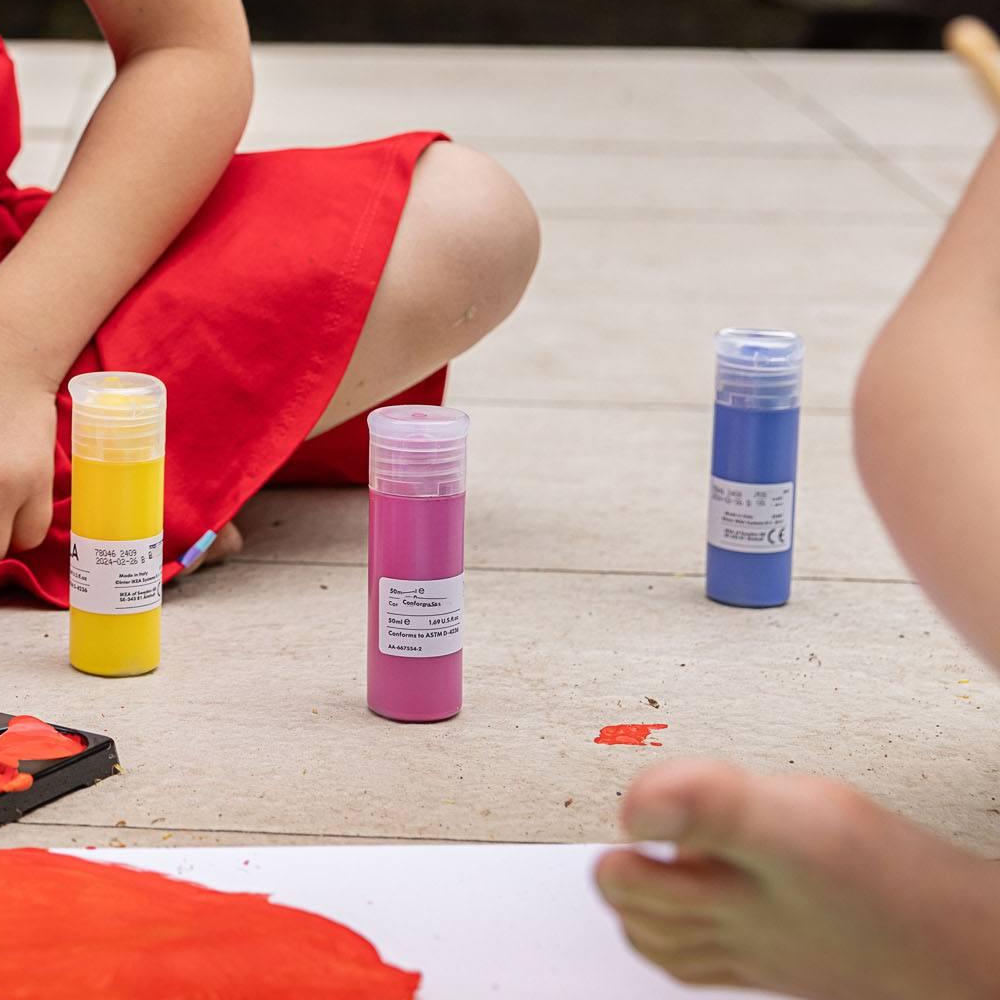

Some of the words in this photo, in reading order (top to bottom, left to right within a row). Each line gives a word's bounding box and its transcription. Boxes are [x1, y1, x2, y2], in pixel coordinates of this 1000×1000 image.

[94, 548, 116, 557] 78046
[120, 549, 137, 557] 2409
[95, 556, 138, 565] 2024-02-26
[388, 630, 417, 638] Conforms
